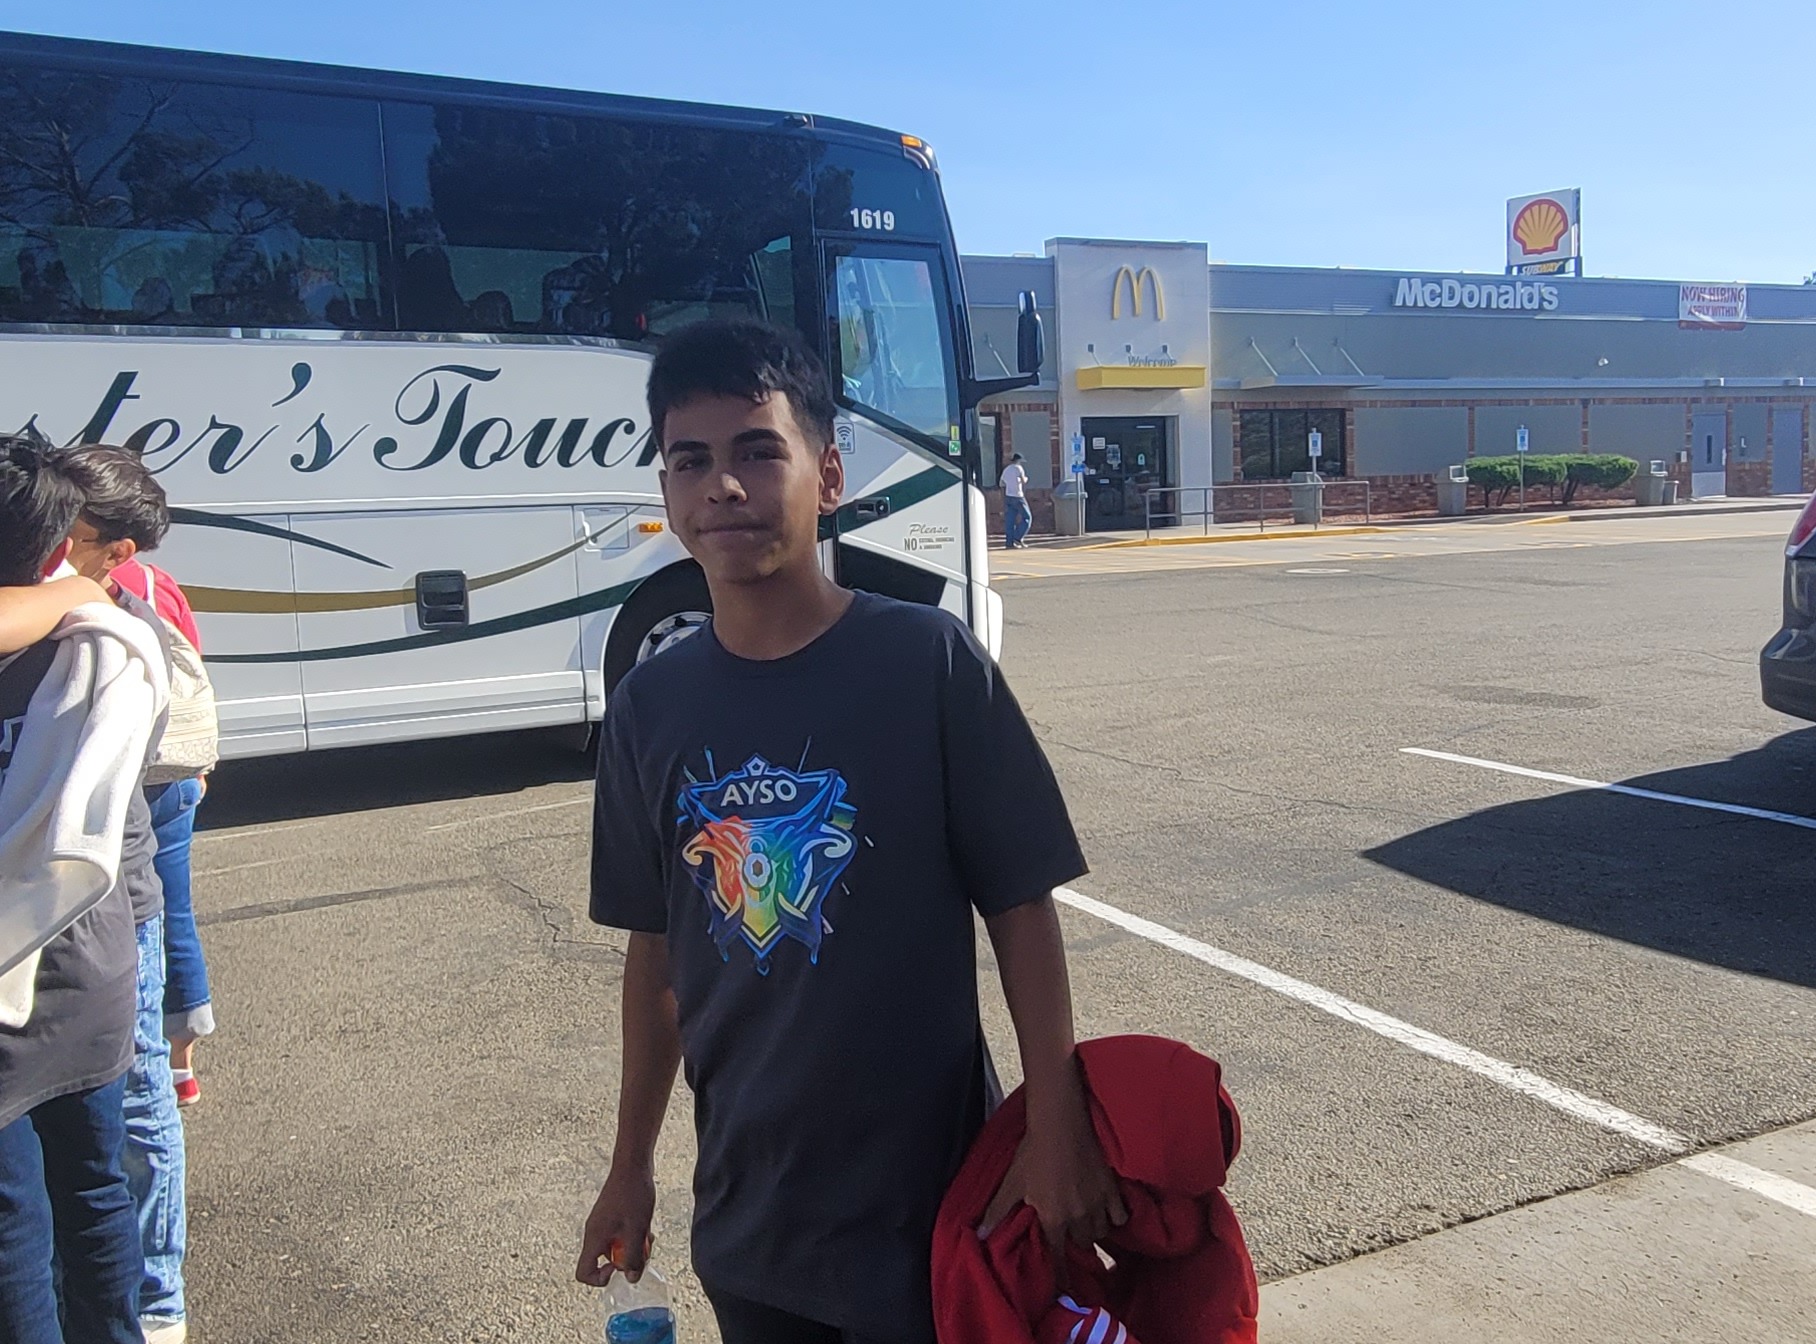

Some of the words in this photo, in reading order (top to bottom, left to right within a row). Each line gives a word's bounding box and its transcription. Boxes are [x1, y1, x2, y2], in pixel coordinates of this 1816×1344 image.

[850, 207, 895, 231] 1619
[1520, 261, 1563, 275] SUBWAY
[1394, 277, 1559, 310] McDonald's
[1682, 286, 1706, 303] NOW
[1709, 286, 1745, 303] HIRING
[1688, 304, 1711, 317] APPLY
[1712, 305, 1738, 318] WITHIN
[1127, 356, 1177, 368] Welcome
[373, 364, 662, 471] Touc
[903, 537, 918, 551] NO
[720, 779, 797, 807] AYSO
